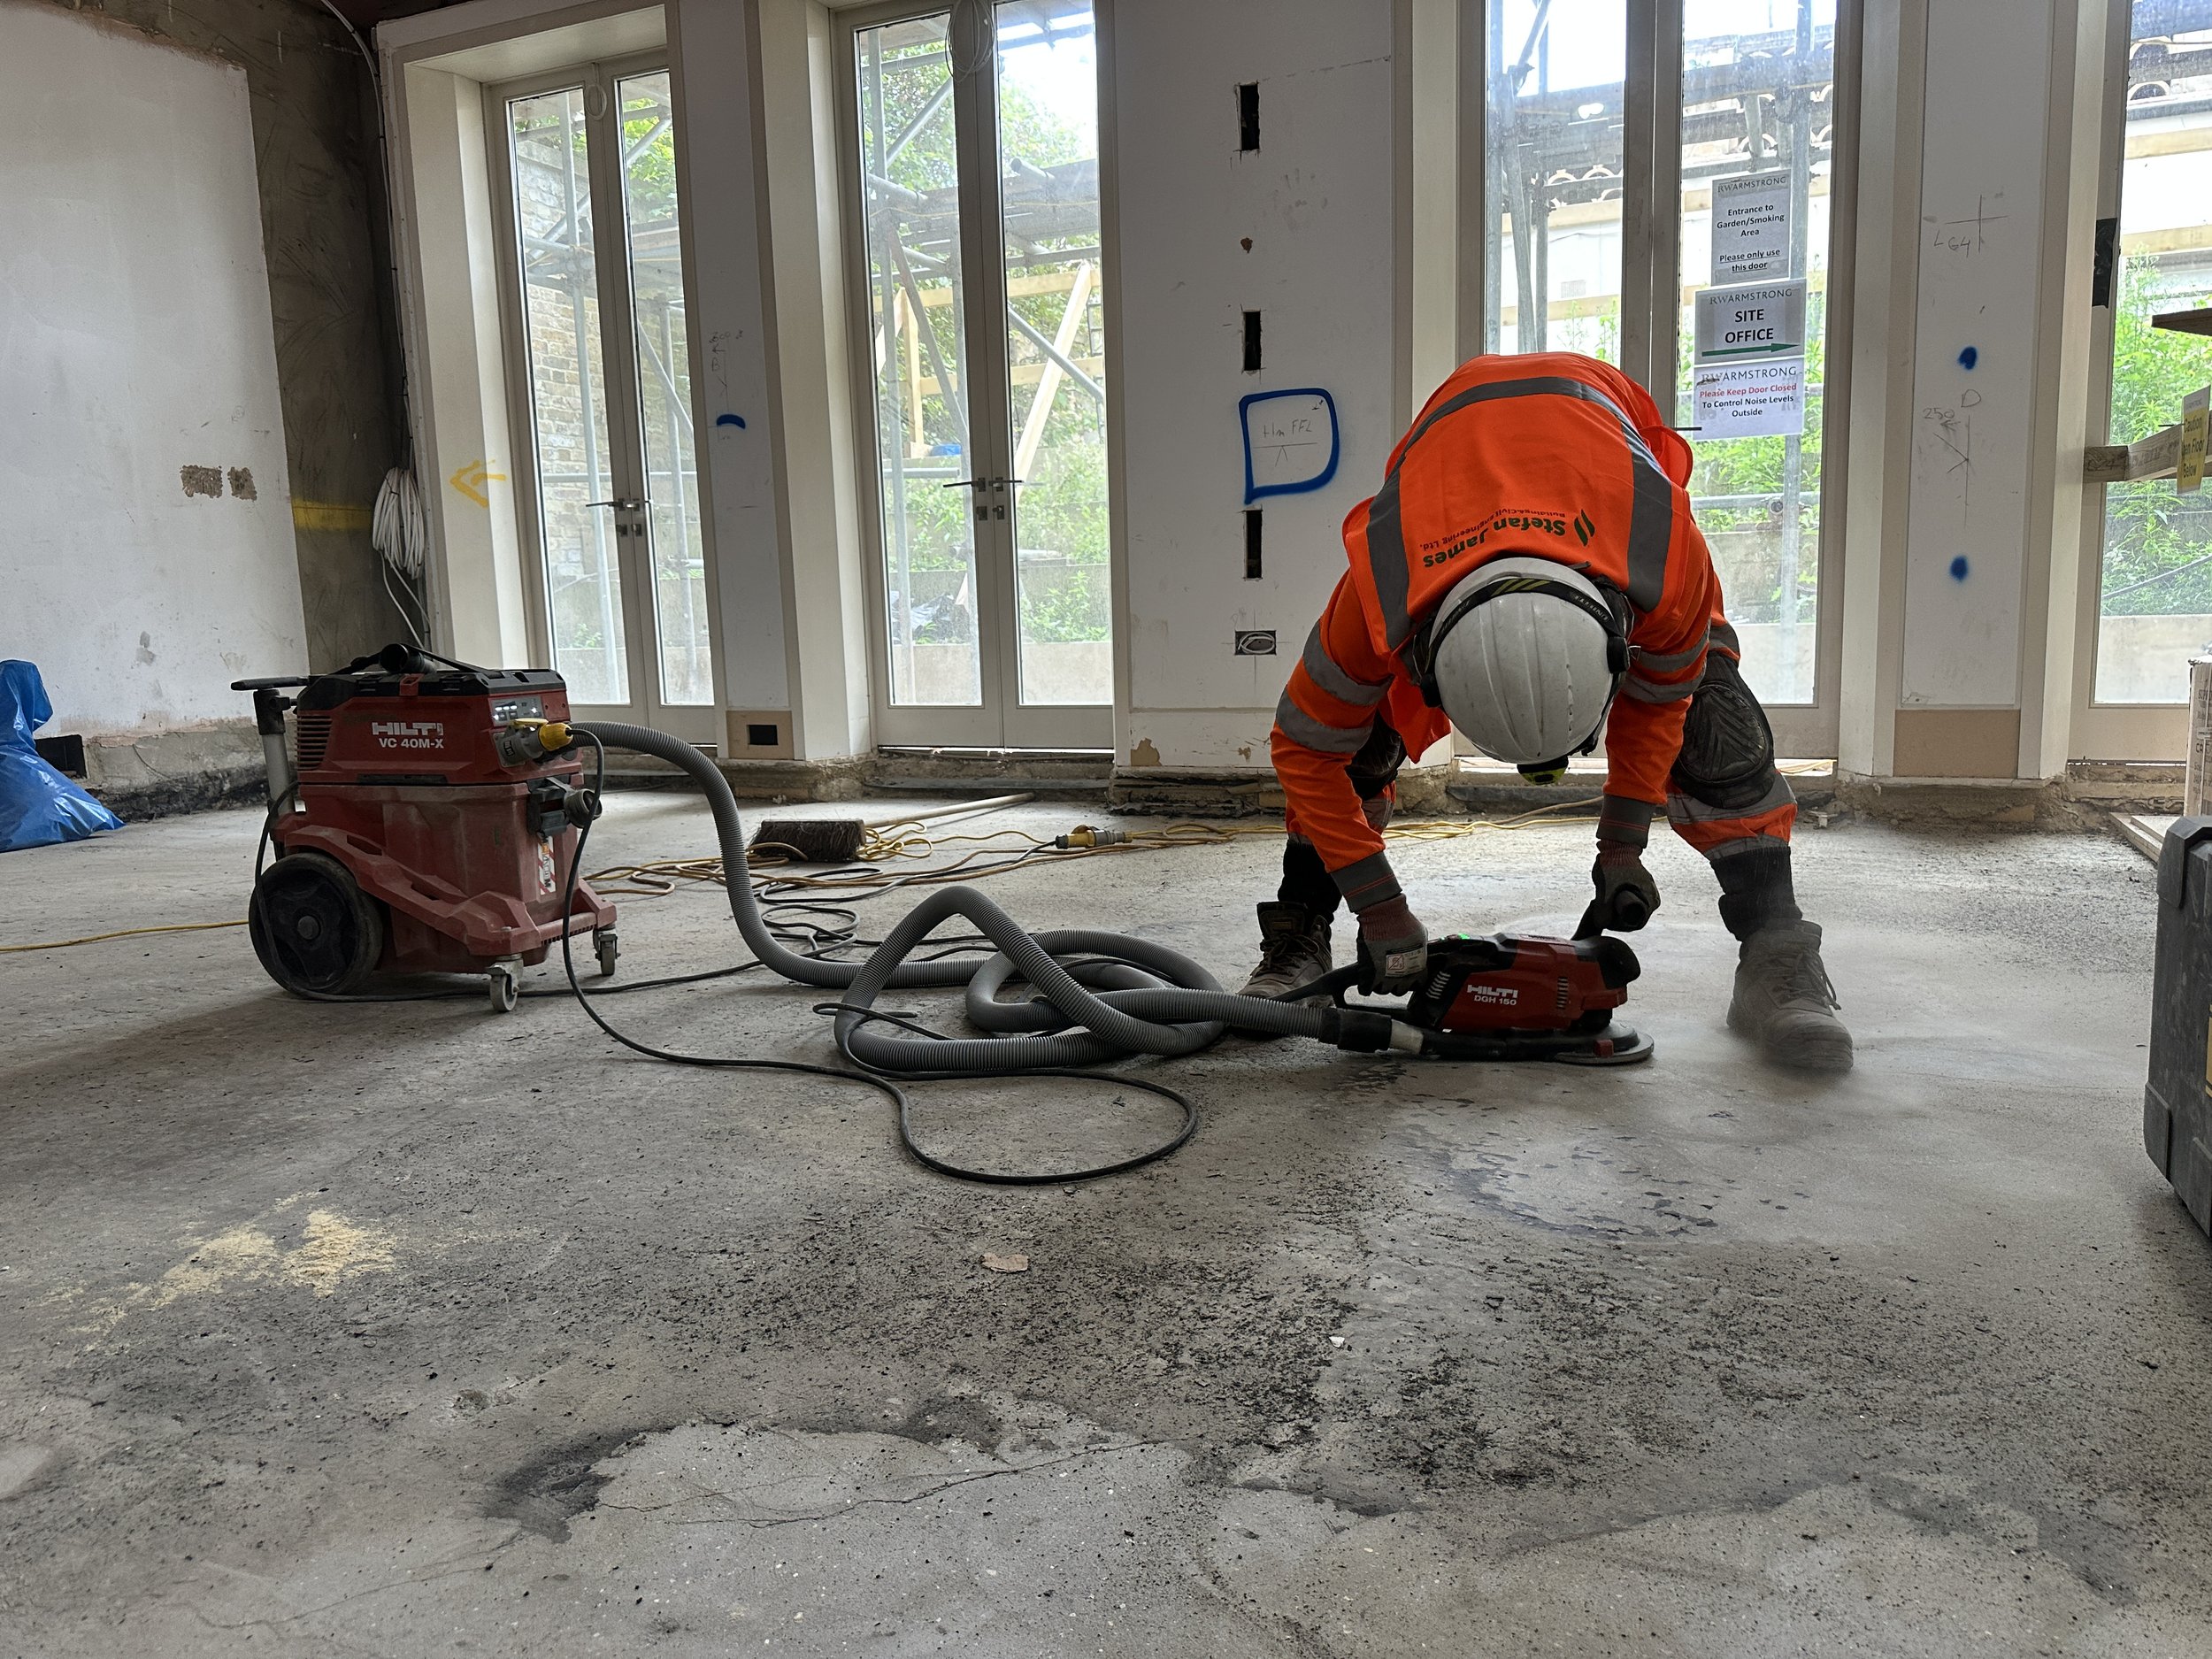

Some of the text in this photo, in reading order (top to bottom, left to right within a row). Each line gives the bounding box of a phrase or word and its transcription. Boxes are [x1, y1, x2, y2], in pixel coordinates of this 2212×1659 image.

[1717, 176, 1786, 193] RWARMSTRONG
[1728, 206, 1763, 217] Entrance
[1717, 214, 1785, 229] Garden/Smoking
[1719, 253, 1745, 263] Please
[1747, 250, 1764, 258] only
[1732, 261, 1768, 273] this door
[1709, 288, 1793, 305] RWARMSTRONG
[1735, 309, 1764, 323] SITE
[1724, 328, 1774, 343] OFFICE
[1700, 383, 1797, 398] Please Keep Door Closed
[1714, 398, 1743, 408] Control
[1745, 396, 1768, 405] Noise
[1770, 395, 1794, 403] Levels
[1732, 408, 1763, 418] Outside
[1423, 517, 1567, 568] Stefan James
[372, 722, 443, 735] HILTI
[379, 738, 444, 749] VC 40M-X
[1467, 984, 1519, 999] HILTI
[1474, 995, 1497, 1004] DGH
